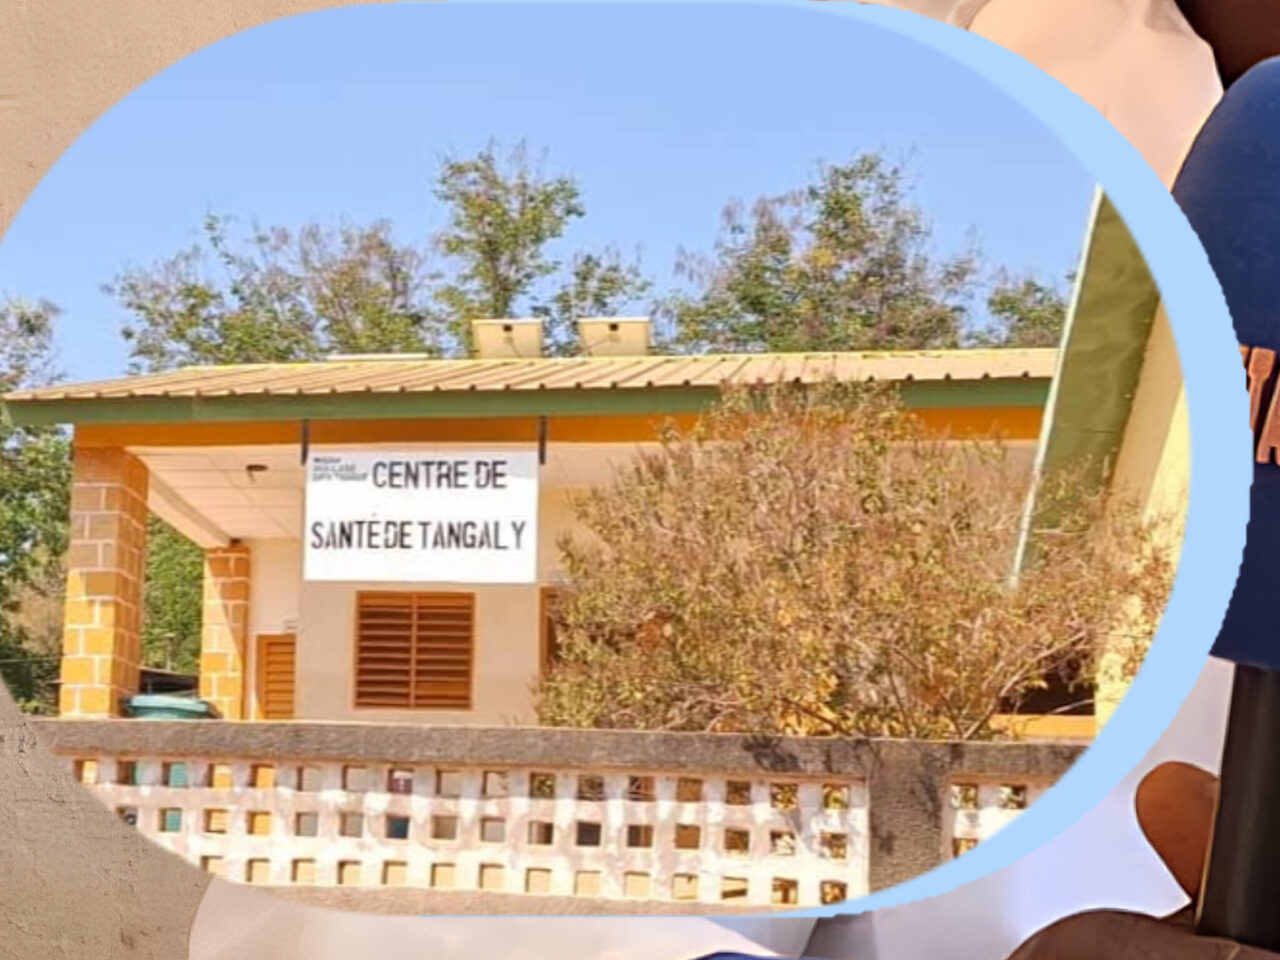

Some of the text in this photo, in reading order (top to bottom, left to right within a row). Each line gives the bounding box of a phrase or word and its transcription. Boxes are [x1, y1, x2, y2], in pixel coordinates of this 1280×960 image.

[373, 460, 507, 488] CENTRE DE
[311, 512, 526, 550] SANTÉ DE TANGALY
